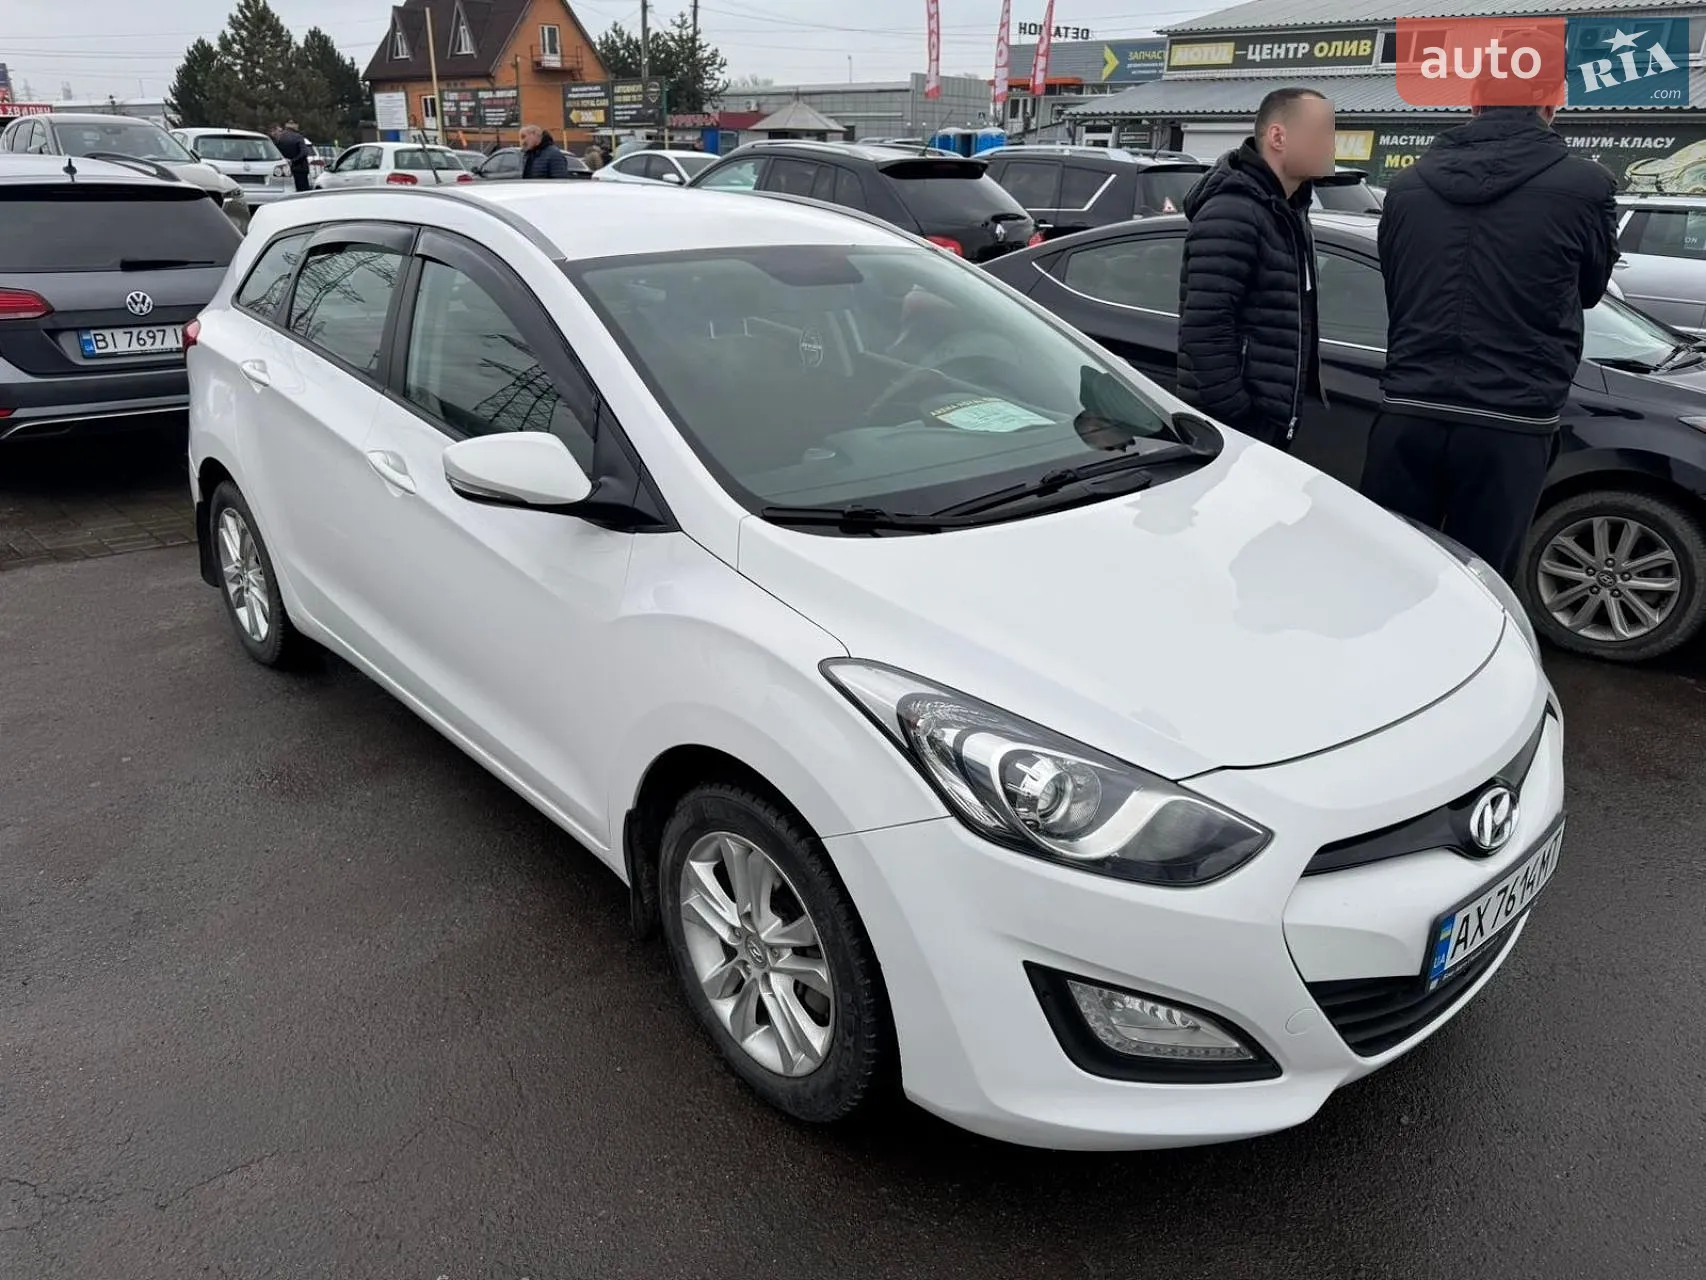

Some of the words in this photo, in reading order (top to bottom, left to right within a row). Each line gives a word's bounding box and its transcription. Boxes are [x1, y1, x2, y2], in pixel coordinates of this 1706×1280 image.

[1128, 50, 1166, 60] ЗАПЧАС
[1313, 39, 1373, 58] ОЛИВ
[1384, 154, 1421, 169] МО
[94, 332, 117, 350] BI
[124, 328, 166, 348] 7697
[1451, 898, 1491, 959] AX
[1491, 856, 1540, 929] 7614
